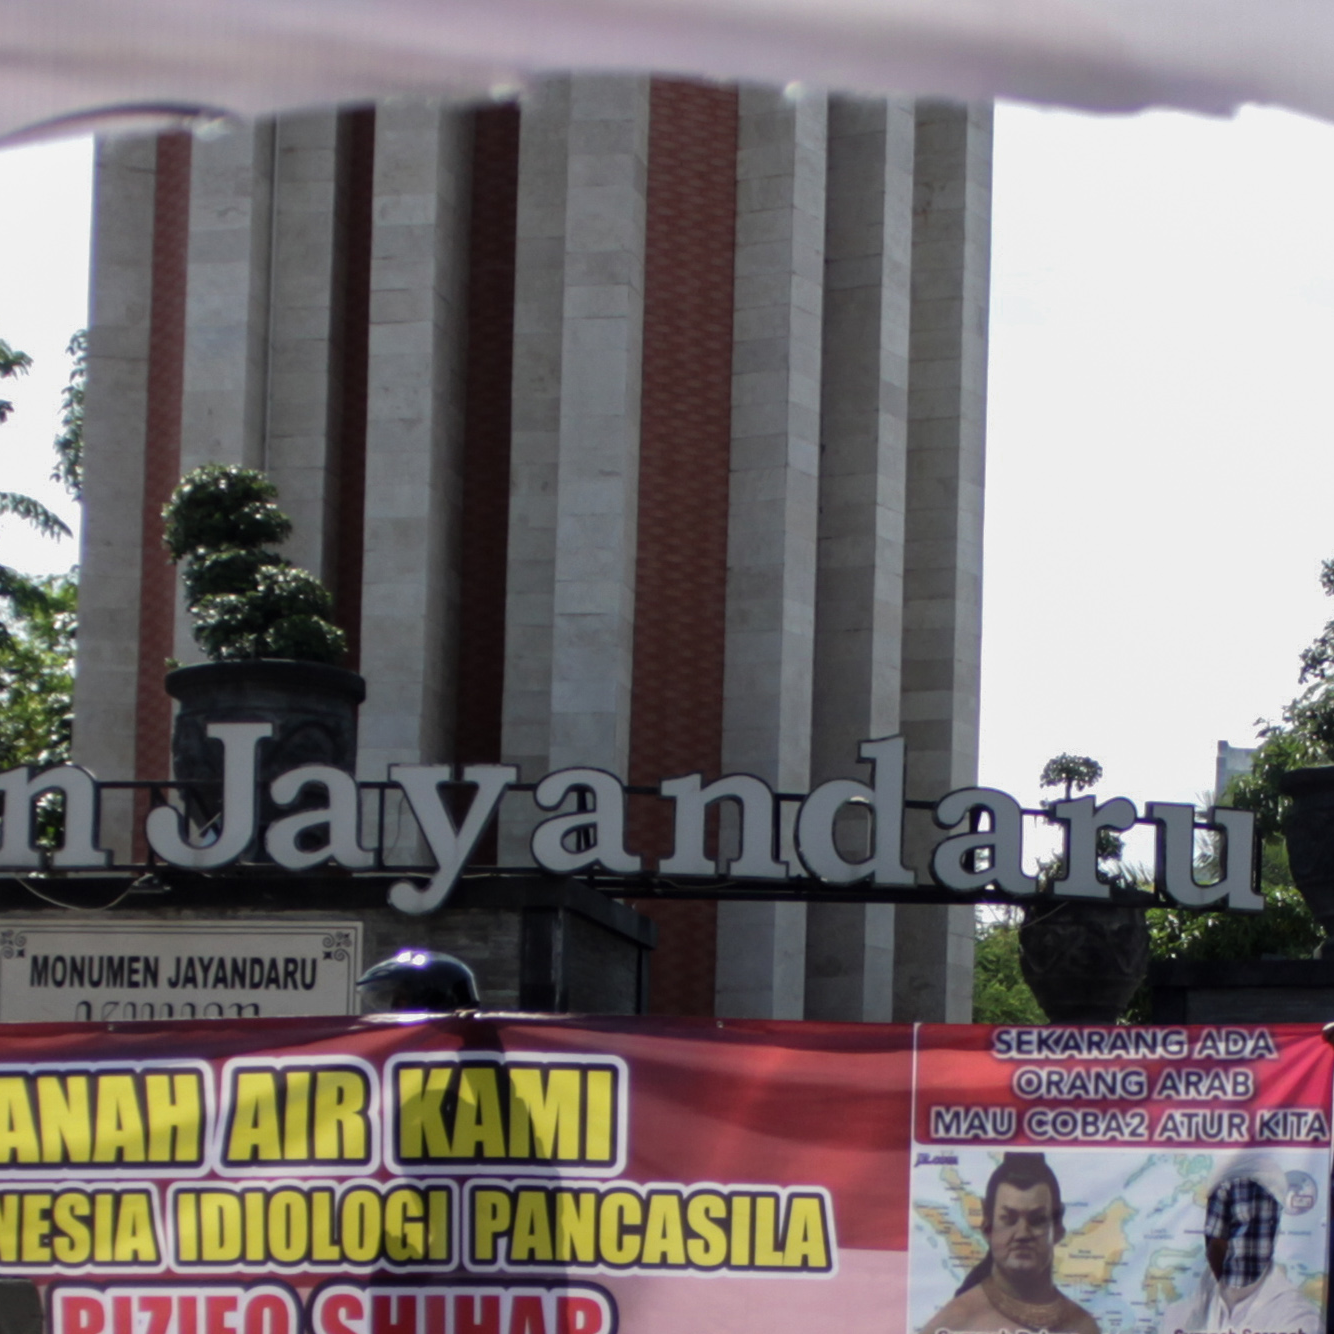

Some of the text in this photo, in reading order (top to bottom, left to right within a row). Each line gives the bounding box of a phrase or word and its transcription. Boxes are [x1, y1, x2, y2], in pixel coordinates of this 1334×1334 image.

[144, 721, 1264, 914] Jayandaru
[29, 954, 318, 990] MONUMEN JAYANDARU
[994, 1029, 1279, 1057] SEKARANG ADA
[1016, 1068, 1253, 1098] ORANG ARAB
[224, 1069, 367, 1162] AIR
[396, 1066, 613, 1161] KAMI
[933, 1109, 1329, 1140] MAU COBA2 ATUR KITA
[176, 1188, 448, 1262] IDIOLOGI
[474, 1189, 828, 1268] PANCASILA
